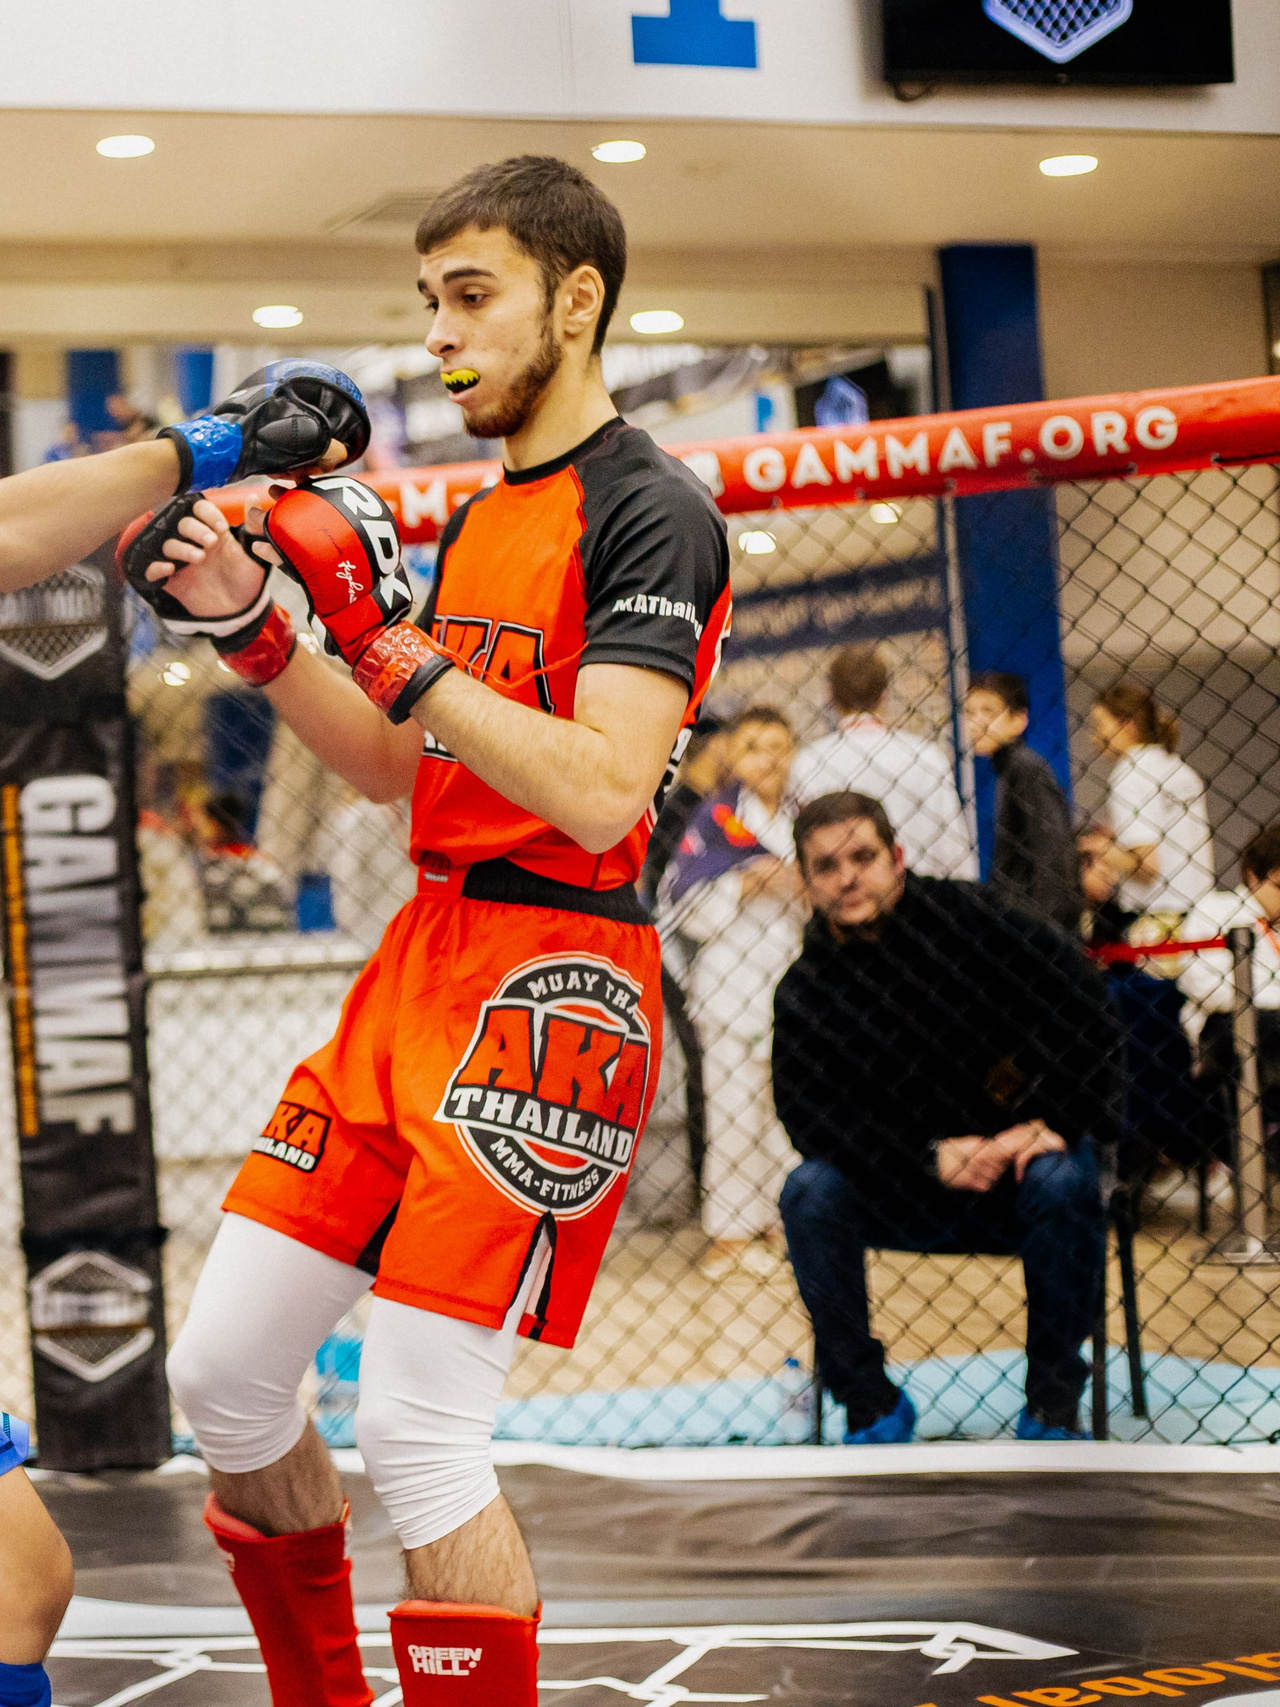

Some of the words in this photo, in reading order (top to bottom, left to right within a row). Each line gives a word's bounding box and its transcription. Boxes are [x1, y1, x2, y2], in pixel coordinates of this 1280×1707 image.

[742, 405, 1179, 493] GAMMAF.ORG
[312, 477, 412, 610] RDX
[526, 970, 600, 999] MUAY
[455, 1008, 648, 1130] AKA
[261, 1102, 328, 1157] KA
[450, 1086, 634, 1165] THAILAND
[489, 1136, 601, 1201] MMA-FITNESS
[407, 1644, 483, 1662] GREEN
[412, 1657, 470, 1676] HILL
